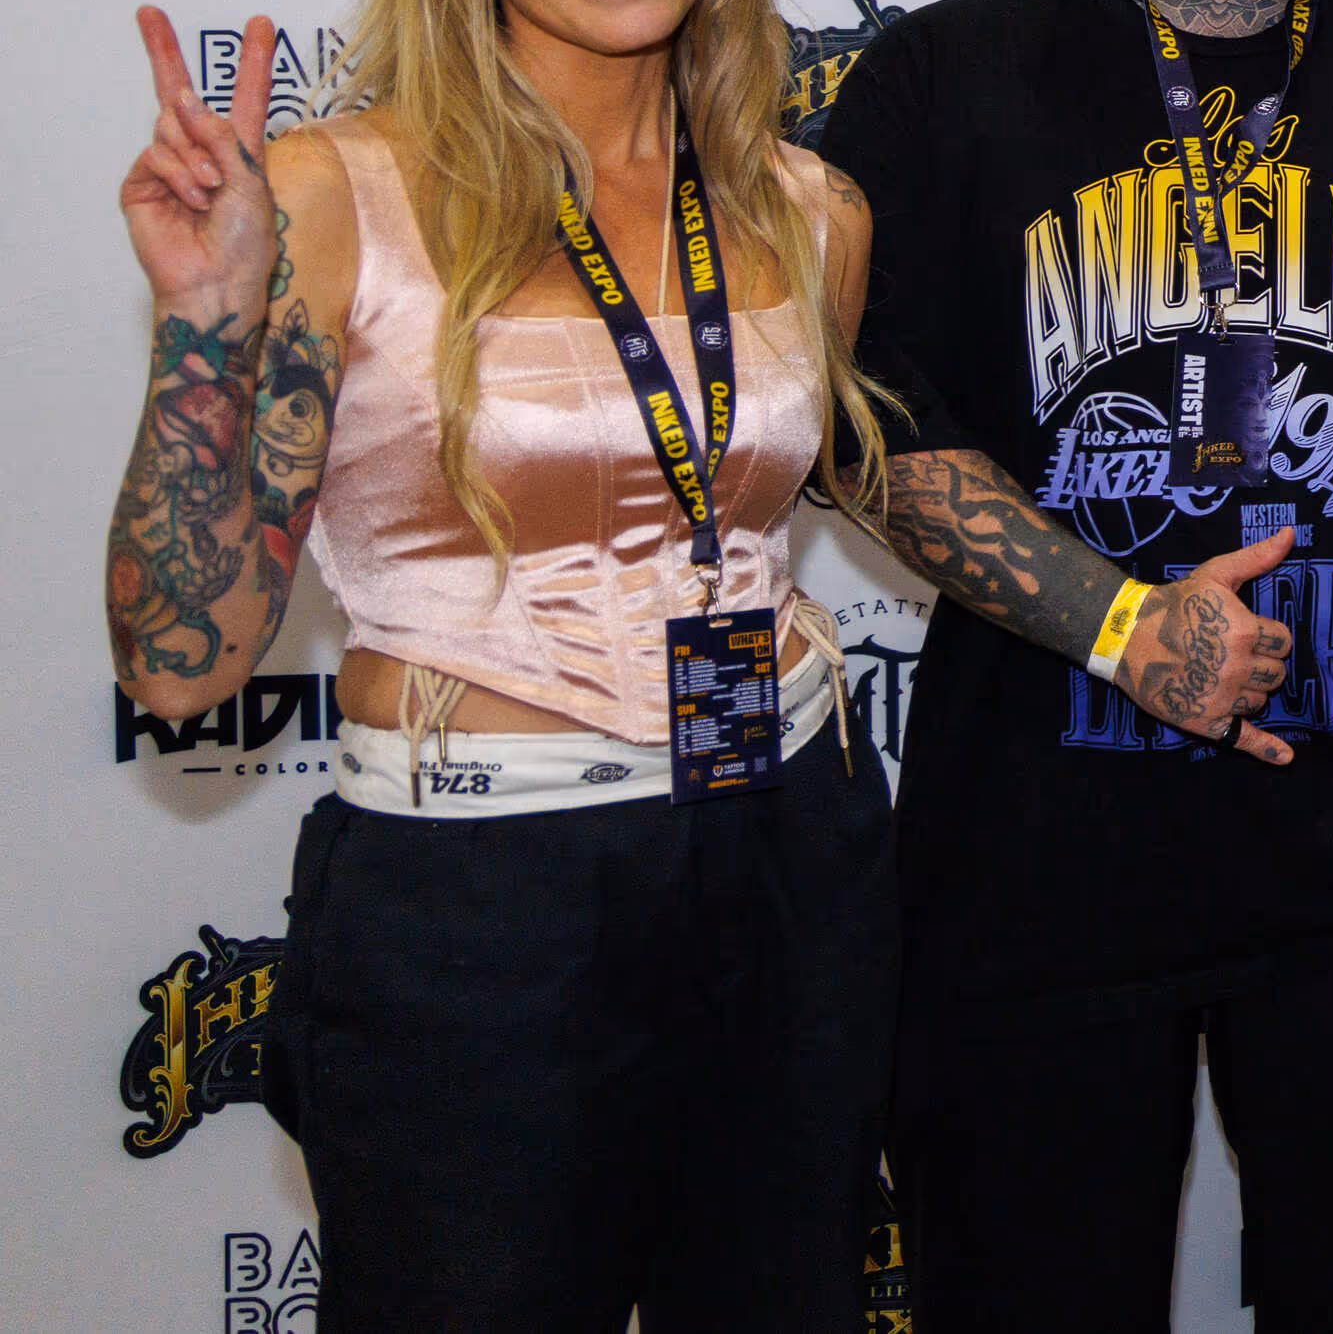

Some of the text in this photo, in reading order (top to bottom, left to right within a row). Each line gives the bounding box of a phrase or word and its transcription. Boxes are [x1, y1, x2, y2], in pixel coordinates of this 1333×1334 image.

[1152, 15, 1180, 59] EXPO
[1182, 136, 1210, 192] INKED
[1224, 140, 1255, 184] EXPO
[679, 179, 717, 293] INKED EXPO
[580, 253, 624, 305] EXPO
[710, 382, 729, 442] EXPO
[1180, 354, 1206, 426] ARTIST
[647, 390, 707, 521] INKED EXPO
[1082, 430, 1117, 446] LOS
[1241, 503, 1296, 526] WESTERN
[114, 674, 339, 764] RADI
[235, 761, 328, 776] COLOR
[224, 1227, 322, 1293] BA
